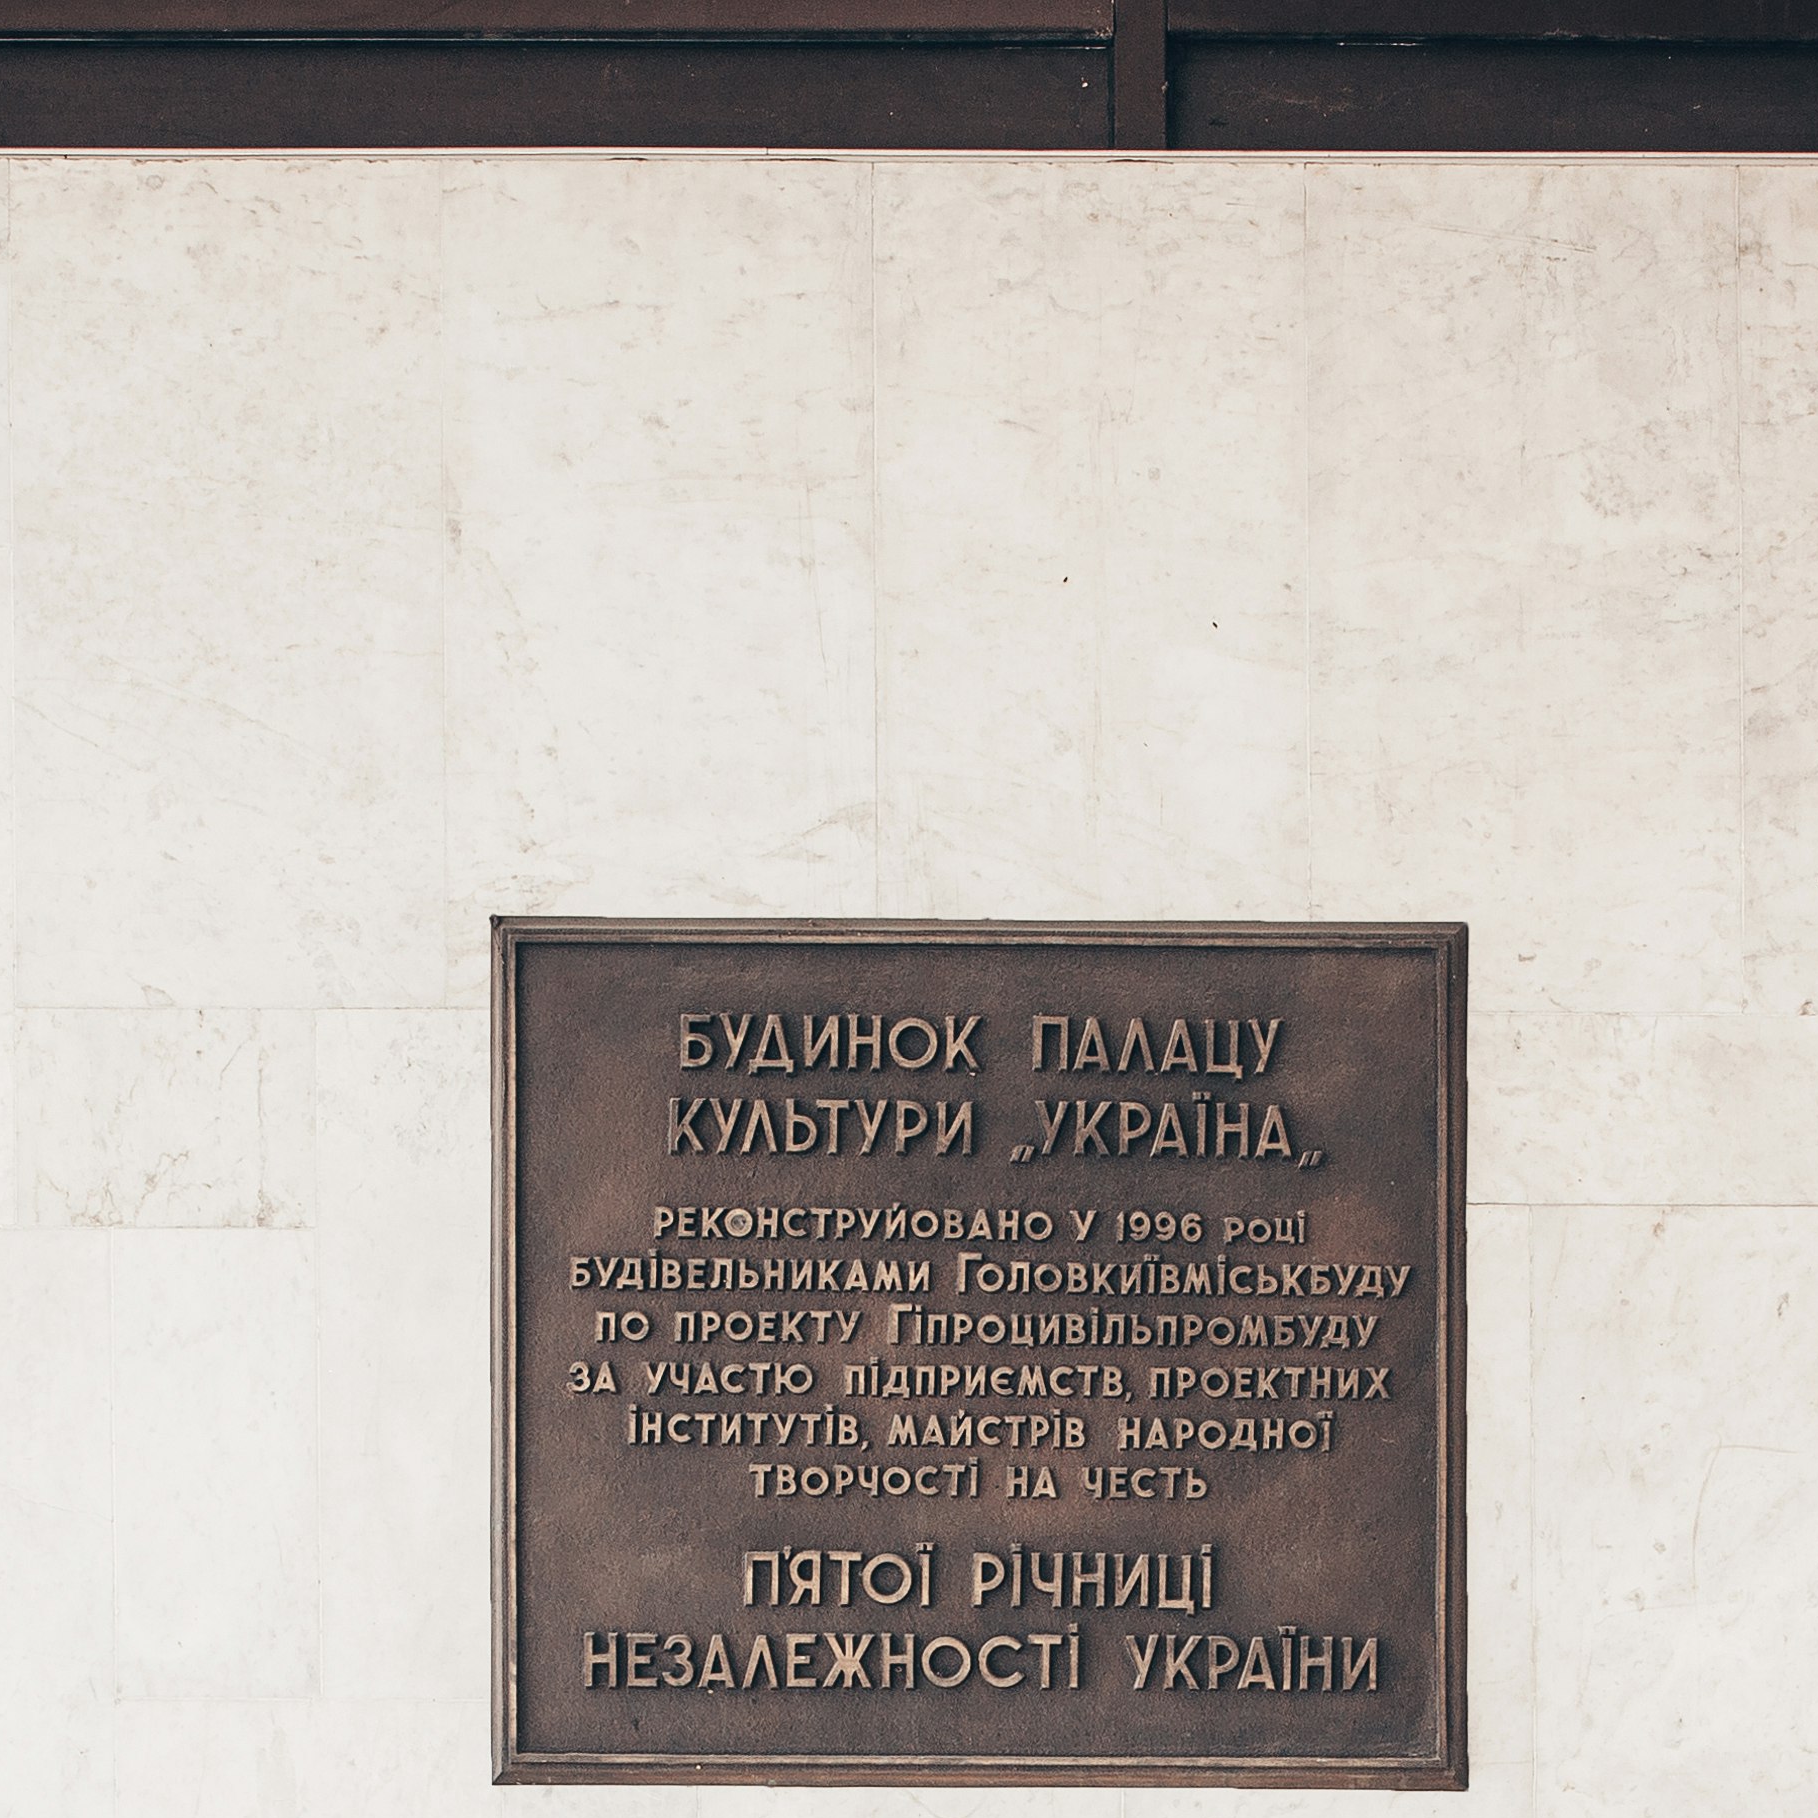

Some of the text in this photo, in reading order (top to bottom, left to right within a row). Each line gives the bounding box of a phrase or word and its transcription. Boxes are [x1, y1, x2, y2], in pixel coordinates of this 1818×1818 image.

[679, 1012, 1284, 1083] БУДИНОК ПАЛАЦУ
[668, 1097, 974, 1157] КУЛЬТУРИ
[653, 1203, 1054, 1241] РЕКОНСТРУЙОВАНО
[1069, 1209, 1098, 1242] У
[1116, 1210, 1203, 1244] 1996
[569, 1248, 933, 1294] БУДІВЕЛЬНИКАМИ
[594, 1309, 652, 1344] ПО
[673, 1309, 862, 1345] ПРОЕКТУ
[567, 1356, 1393, 1402] ЗА УЧАСТЮ ПІДПРИЄМСТВ, ПРОЕКТНИХ
[627, 1404, 1335, 1453] ІНСТИТУТІВ, МАЙСТРІВ НАРОДНОЇ
[748, 1456, 1208, 1500] ТВОРЧОСТІ НА ЧЕСТЬ
[970, 1542, 1214, 1617] РІЧНИЦІ
[583, 1622, 1379, 1693] НЕЗАЛЕЖНОСТІ УКРАЇНИ
